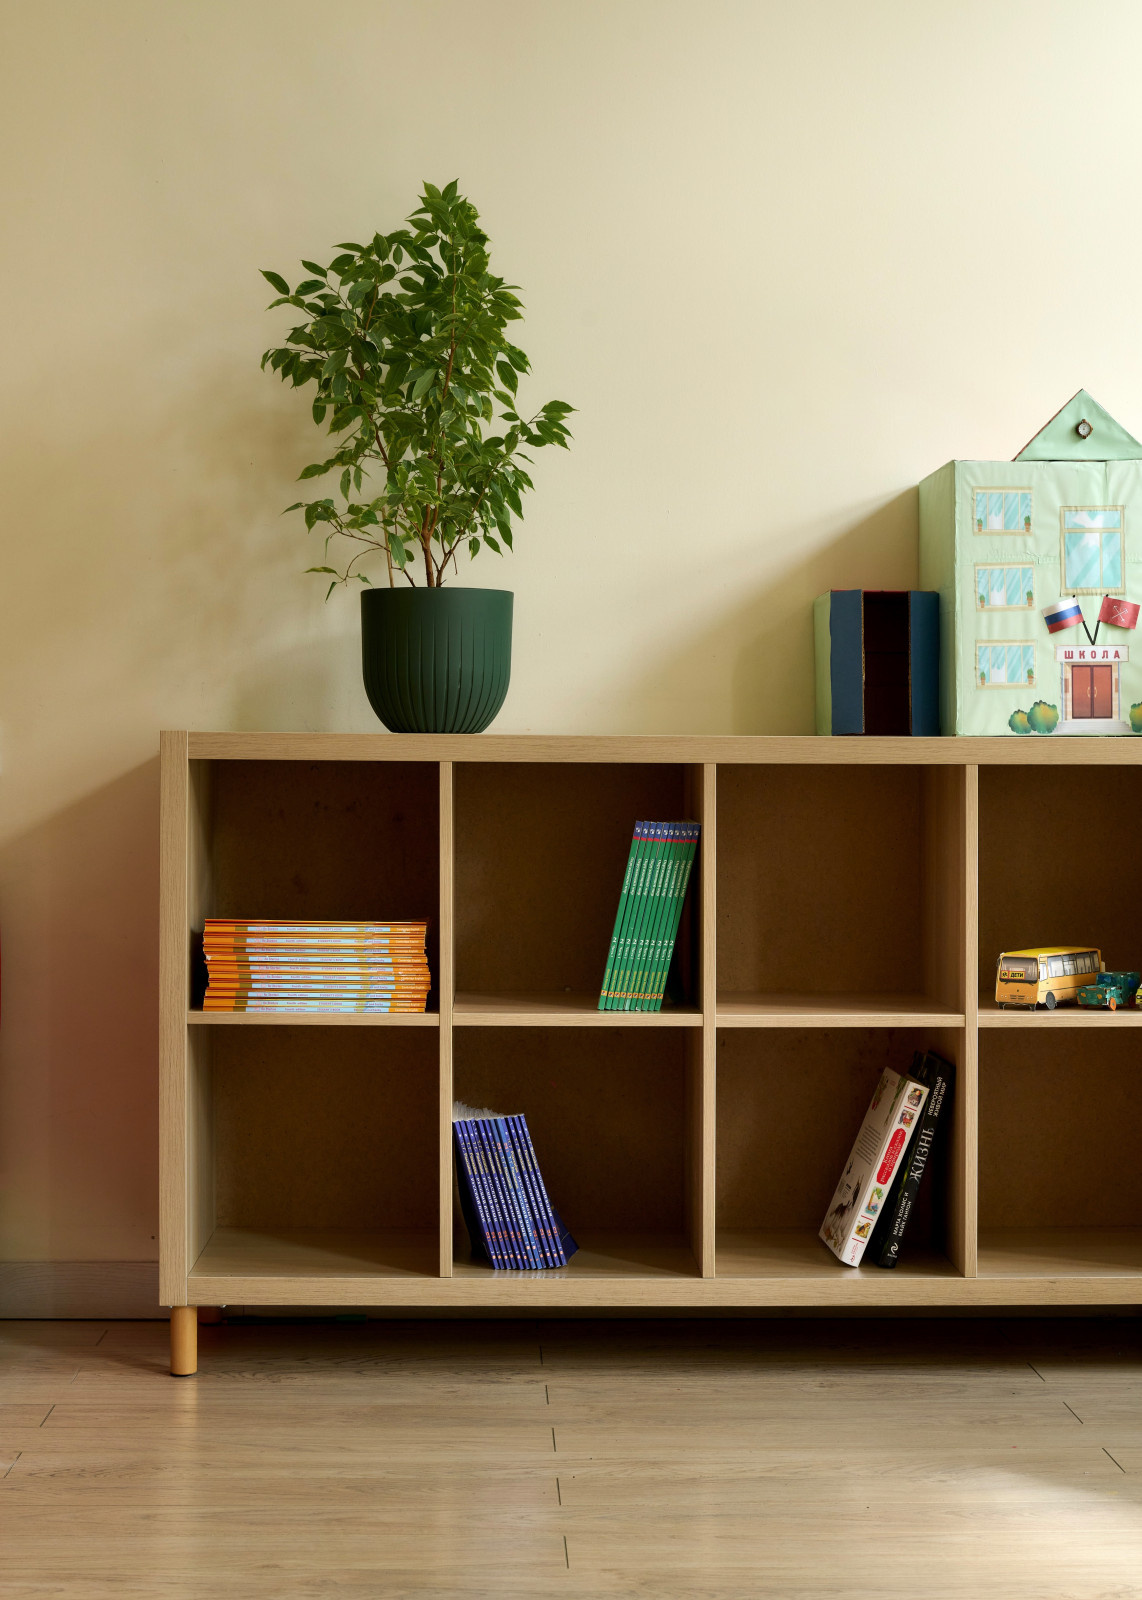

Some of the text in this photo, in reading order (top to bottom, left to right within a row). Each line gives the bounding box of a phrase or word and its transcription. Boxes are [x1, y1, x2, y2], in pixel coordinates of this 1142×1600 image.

[1064, 650, 1120, 659] ШКОЛА
[928, 1076, 943, 1116] НЕВЕРОЯТНЫЙ
[909, 1128, 935, 1184] ЖИЗНЬ
[893, 1218, 901, 1235] МАРТА
[898, 1197, 908, 1217] ХОЛМС
